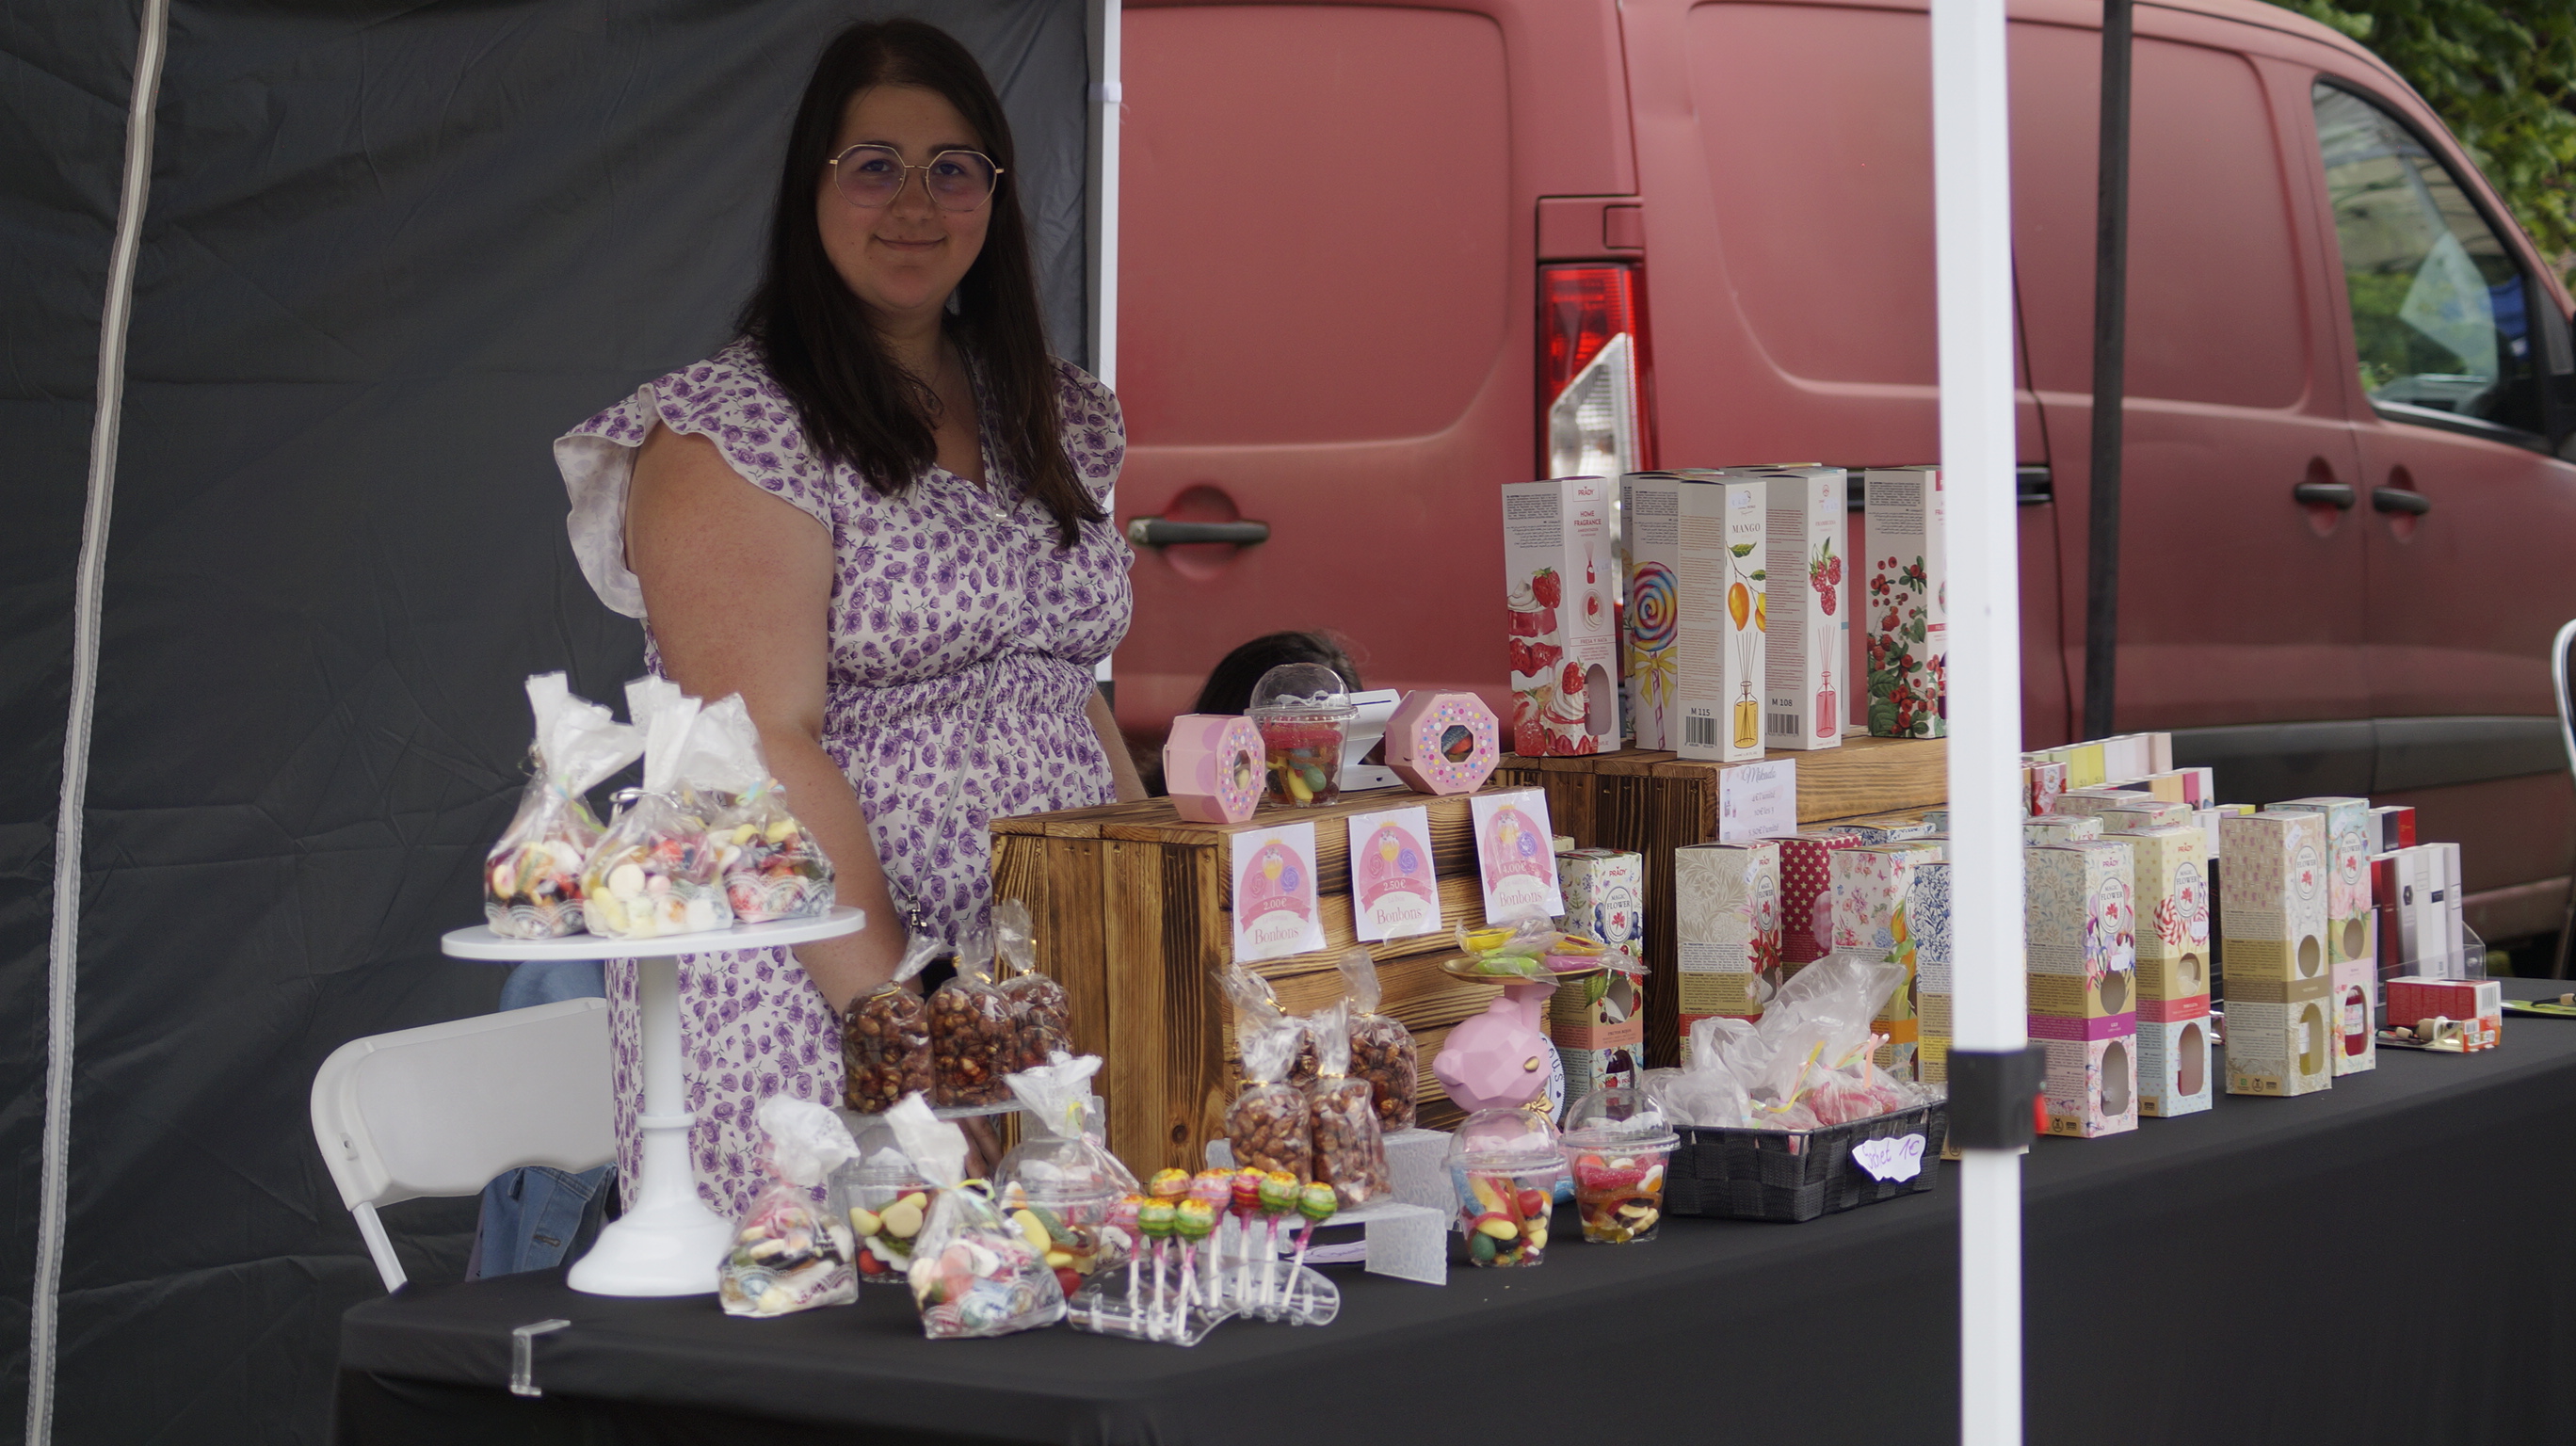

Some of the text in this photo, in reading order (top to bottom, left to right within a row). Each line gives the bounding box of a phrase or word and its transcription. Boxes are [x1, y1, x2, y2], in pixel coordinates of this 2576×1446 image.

[1731, 522, 1761, 534] MANGO
[1779, 699, 1793, 707] 108
[1699, 708, 1711, 716] 115
[1502, 862, 1526, 874] 4.00€
[2297, 860, 2316, 868] FLOWER
[1383, 878, 1406, 891] 2.50€
[2176, 876, 2197, 885] FLOWER
[1499, 891, 1543, 907] Bonbons
[1758, 890, 1773, 898] FLOWER
[2101, 892, 2123, 901] FLOWER
[1264, 897, 1287, 910] 2.00€
[1607, 901, 1631, 909] FLOWER
[1377, 907, 1423, 924] Bonbons
[1254, 925, 1299, 944] Bonbons
[1899, 1137, 1920, 1160] 1€
